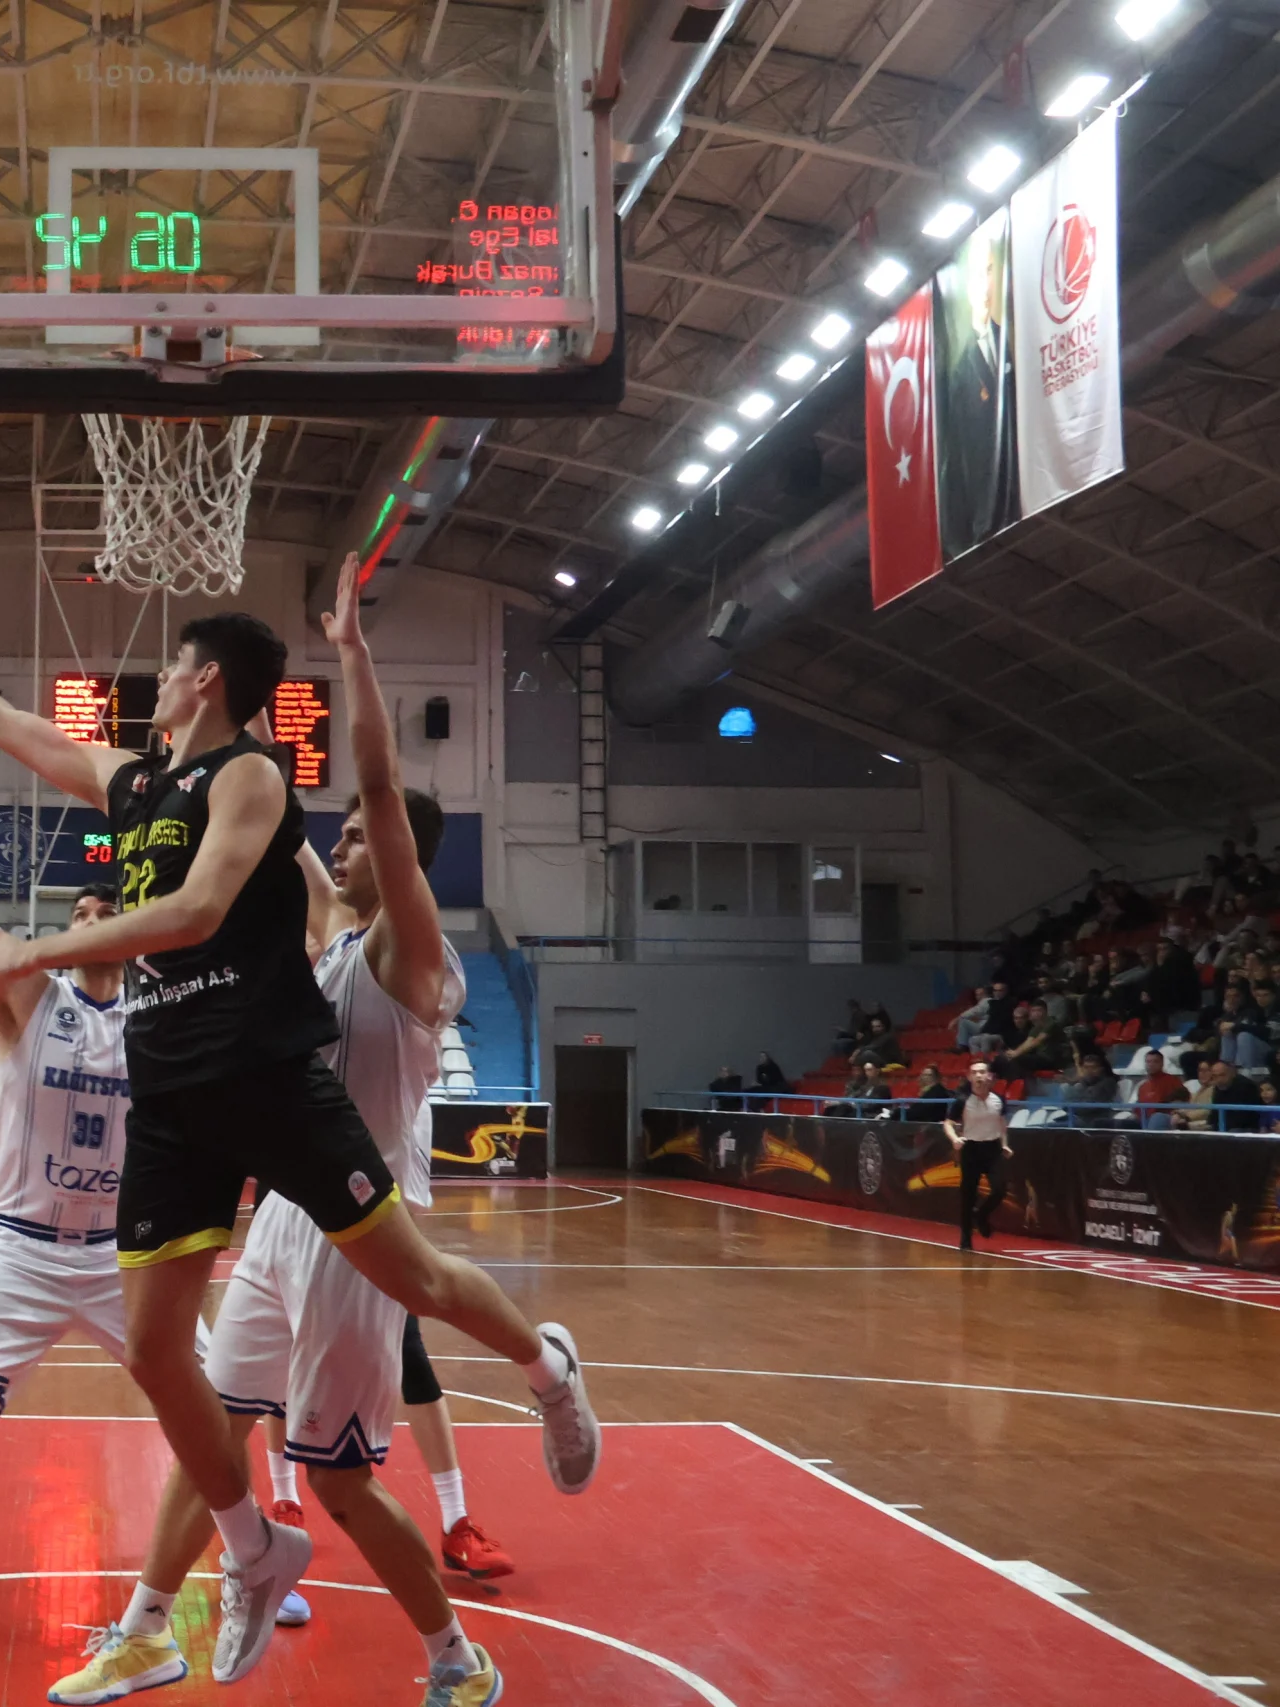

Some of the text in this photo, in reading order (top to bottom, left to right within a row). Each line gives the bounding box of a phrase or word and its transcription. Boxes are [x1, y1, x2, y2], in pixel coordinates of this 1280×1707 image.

[85, 845, 112, 863] 20
[42, 1066, 133, 1099] KAĞITSPO
[72, 1110, 106, 1150] 39
[1084, 1221, 1126, 1242] KOCAELİ
[1132, 1223, 1162, 1247] İZMİT
